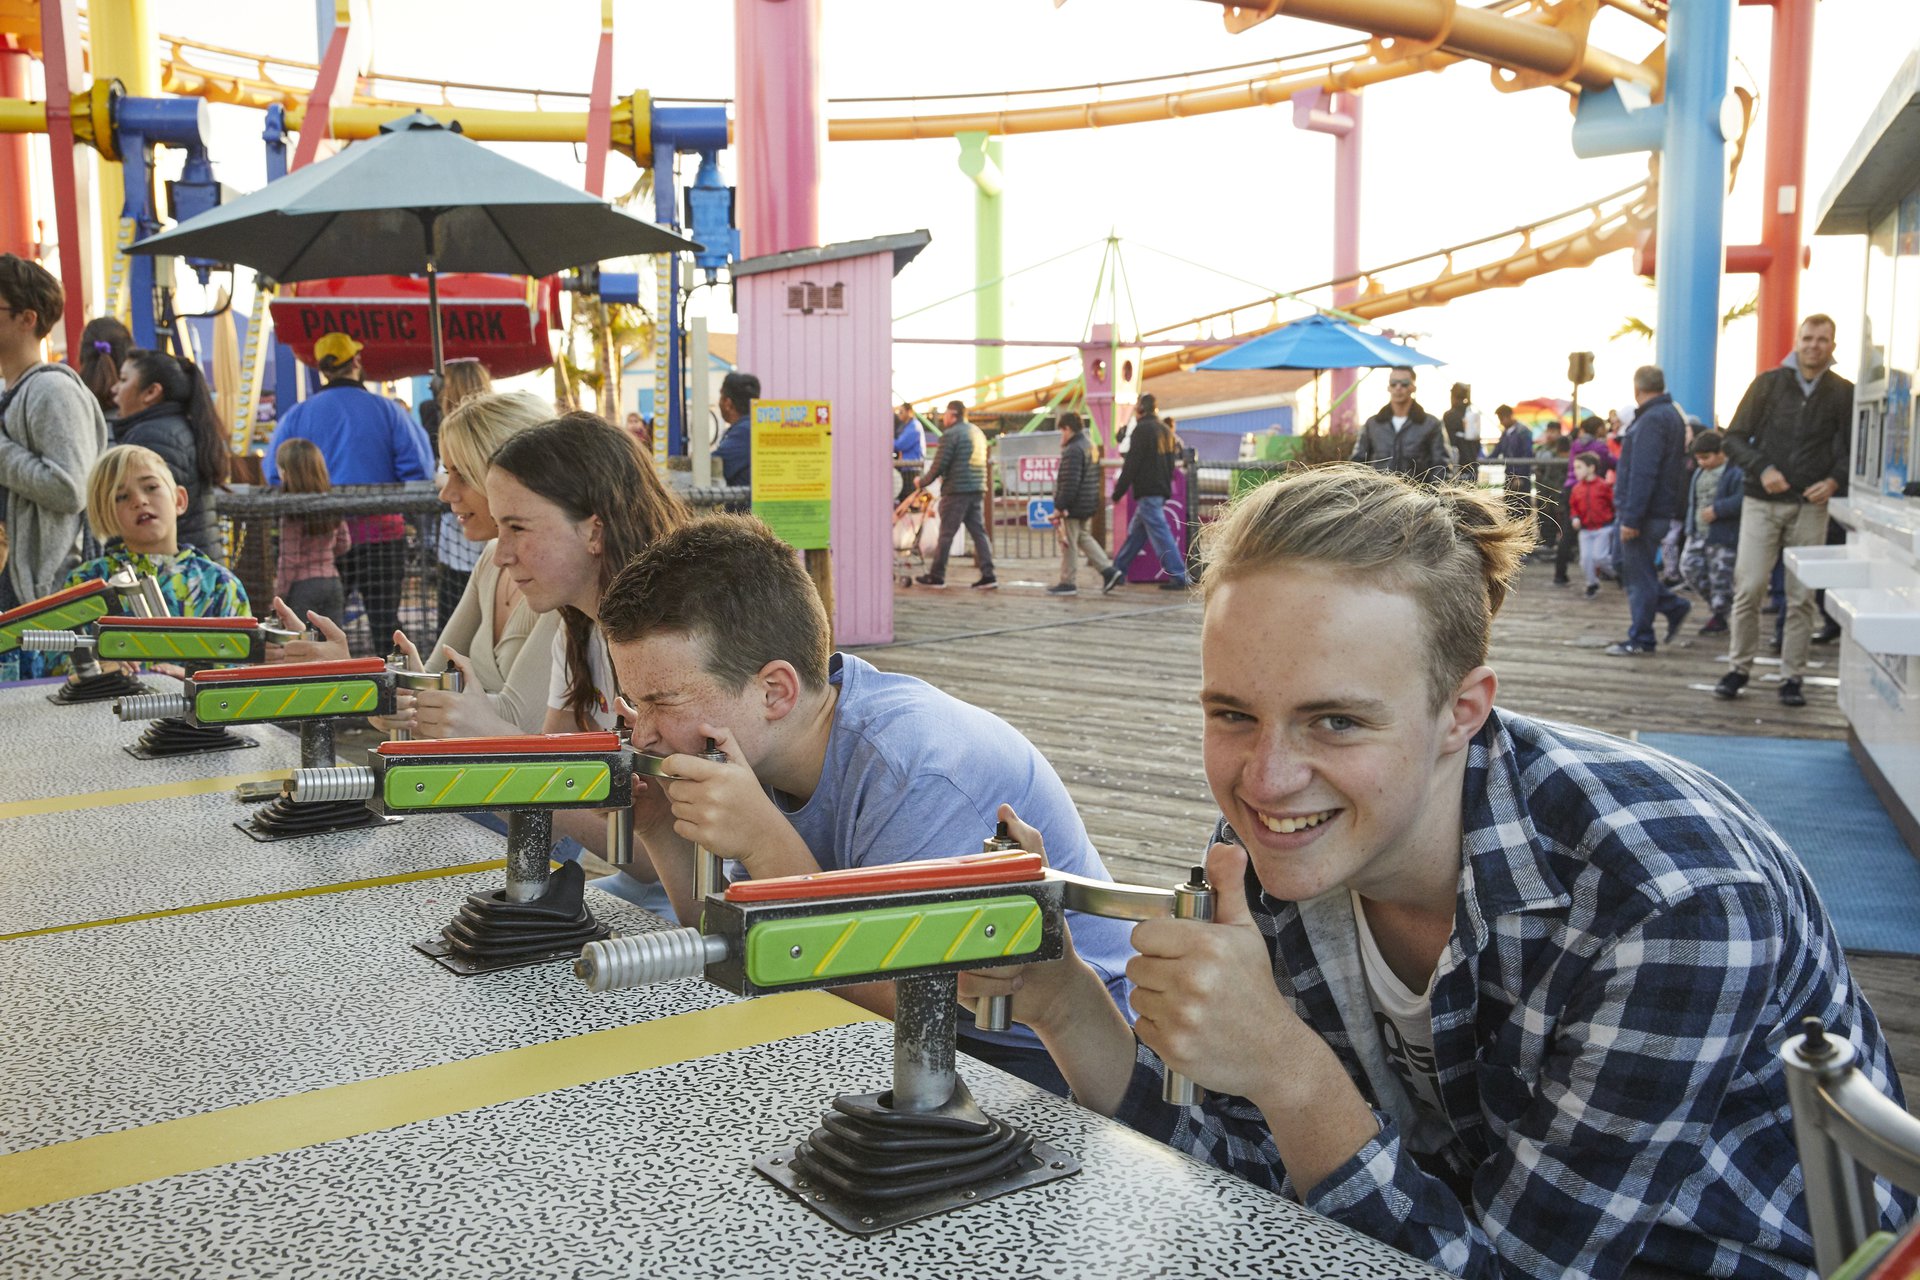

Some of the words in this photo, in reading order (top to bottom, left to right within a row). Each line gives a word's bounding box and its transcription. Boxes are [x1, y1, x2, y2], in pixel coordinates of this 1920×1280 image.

[301, 308, 417, 341] PACIFIC
[429, 309, 506, 341] ARK
[1025, 458, 1058, 470] EXIT
[1023, 470, 1059, 481] ONLY
